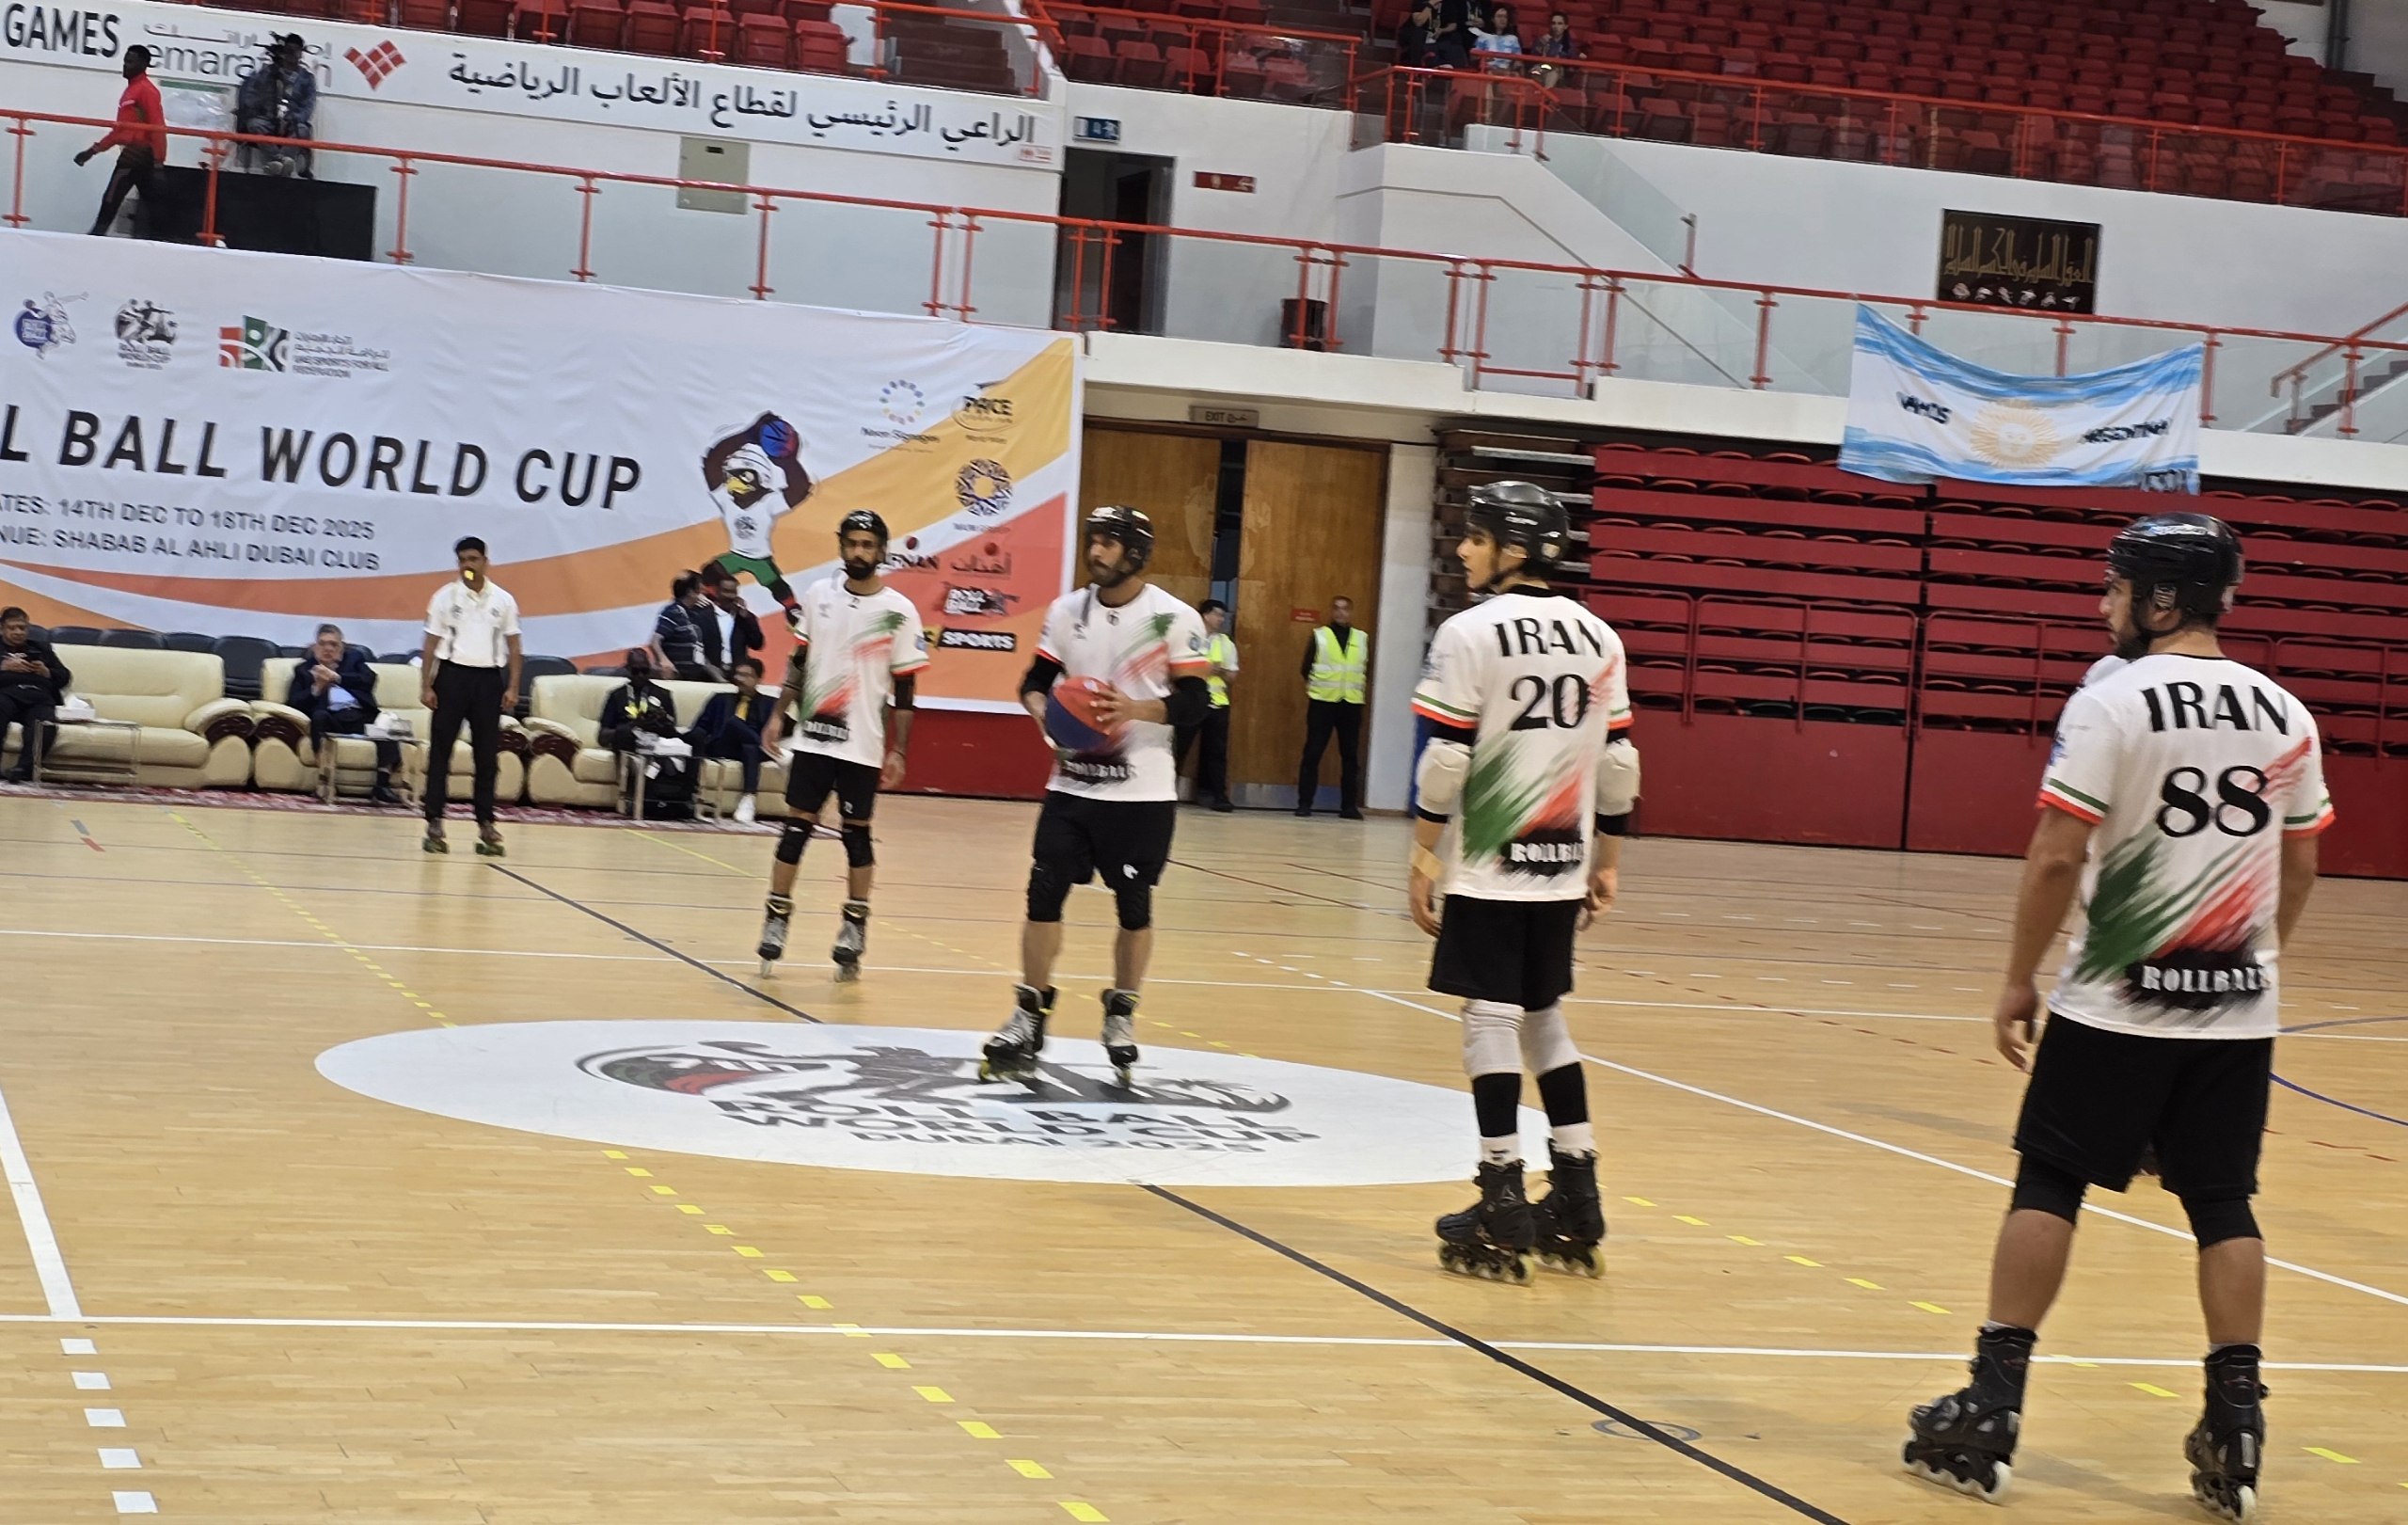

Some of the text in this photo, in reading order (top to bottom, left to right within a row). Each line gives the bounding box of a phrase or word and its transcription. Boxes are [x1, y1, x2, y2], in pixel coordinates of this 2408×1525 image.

[3, 2, 122, 59] GAMES
[448, 52, 1036, 151] الراعي الرئيسي لقطاع الألعاب الرياضية
[56, 408, 229, 480] BALL
[261, 425, 489, 499] WORLD
[515, 448, 643, 511] CUP
[0, 492, 51, 516] TES:
[58, 498, 115, 519] 14TH
[119, 502, 168, 525] DEC
[172, 507, 205, 527] TO
[271, 515, 319, 535] DEC
[322, 517, 376, 540] 2025
[53, 528, 148, 555] SHABAB
[152, 537, 182, 557] AL
[188, 538, 241, 562] AHLI
[246, 543, 316, 567] DUBAI
[323, 549, 382, 572] CLUB
[1493, 617, 1605, 658] IRAN
[1510, 673, 1591, 732] 20
[2141, 681, 2289, 737] IRAN
[2156, 764, 2272, 837] 88
[708, 1100, 1299, 1131] ROLL BALL
[720, 1113, 1322, 1143] WORLD CUP
[849, 1131, 1267, 1152] DUBAI 2025
